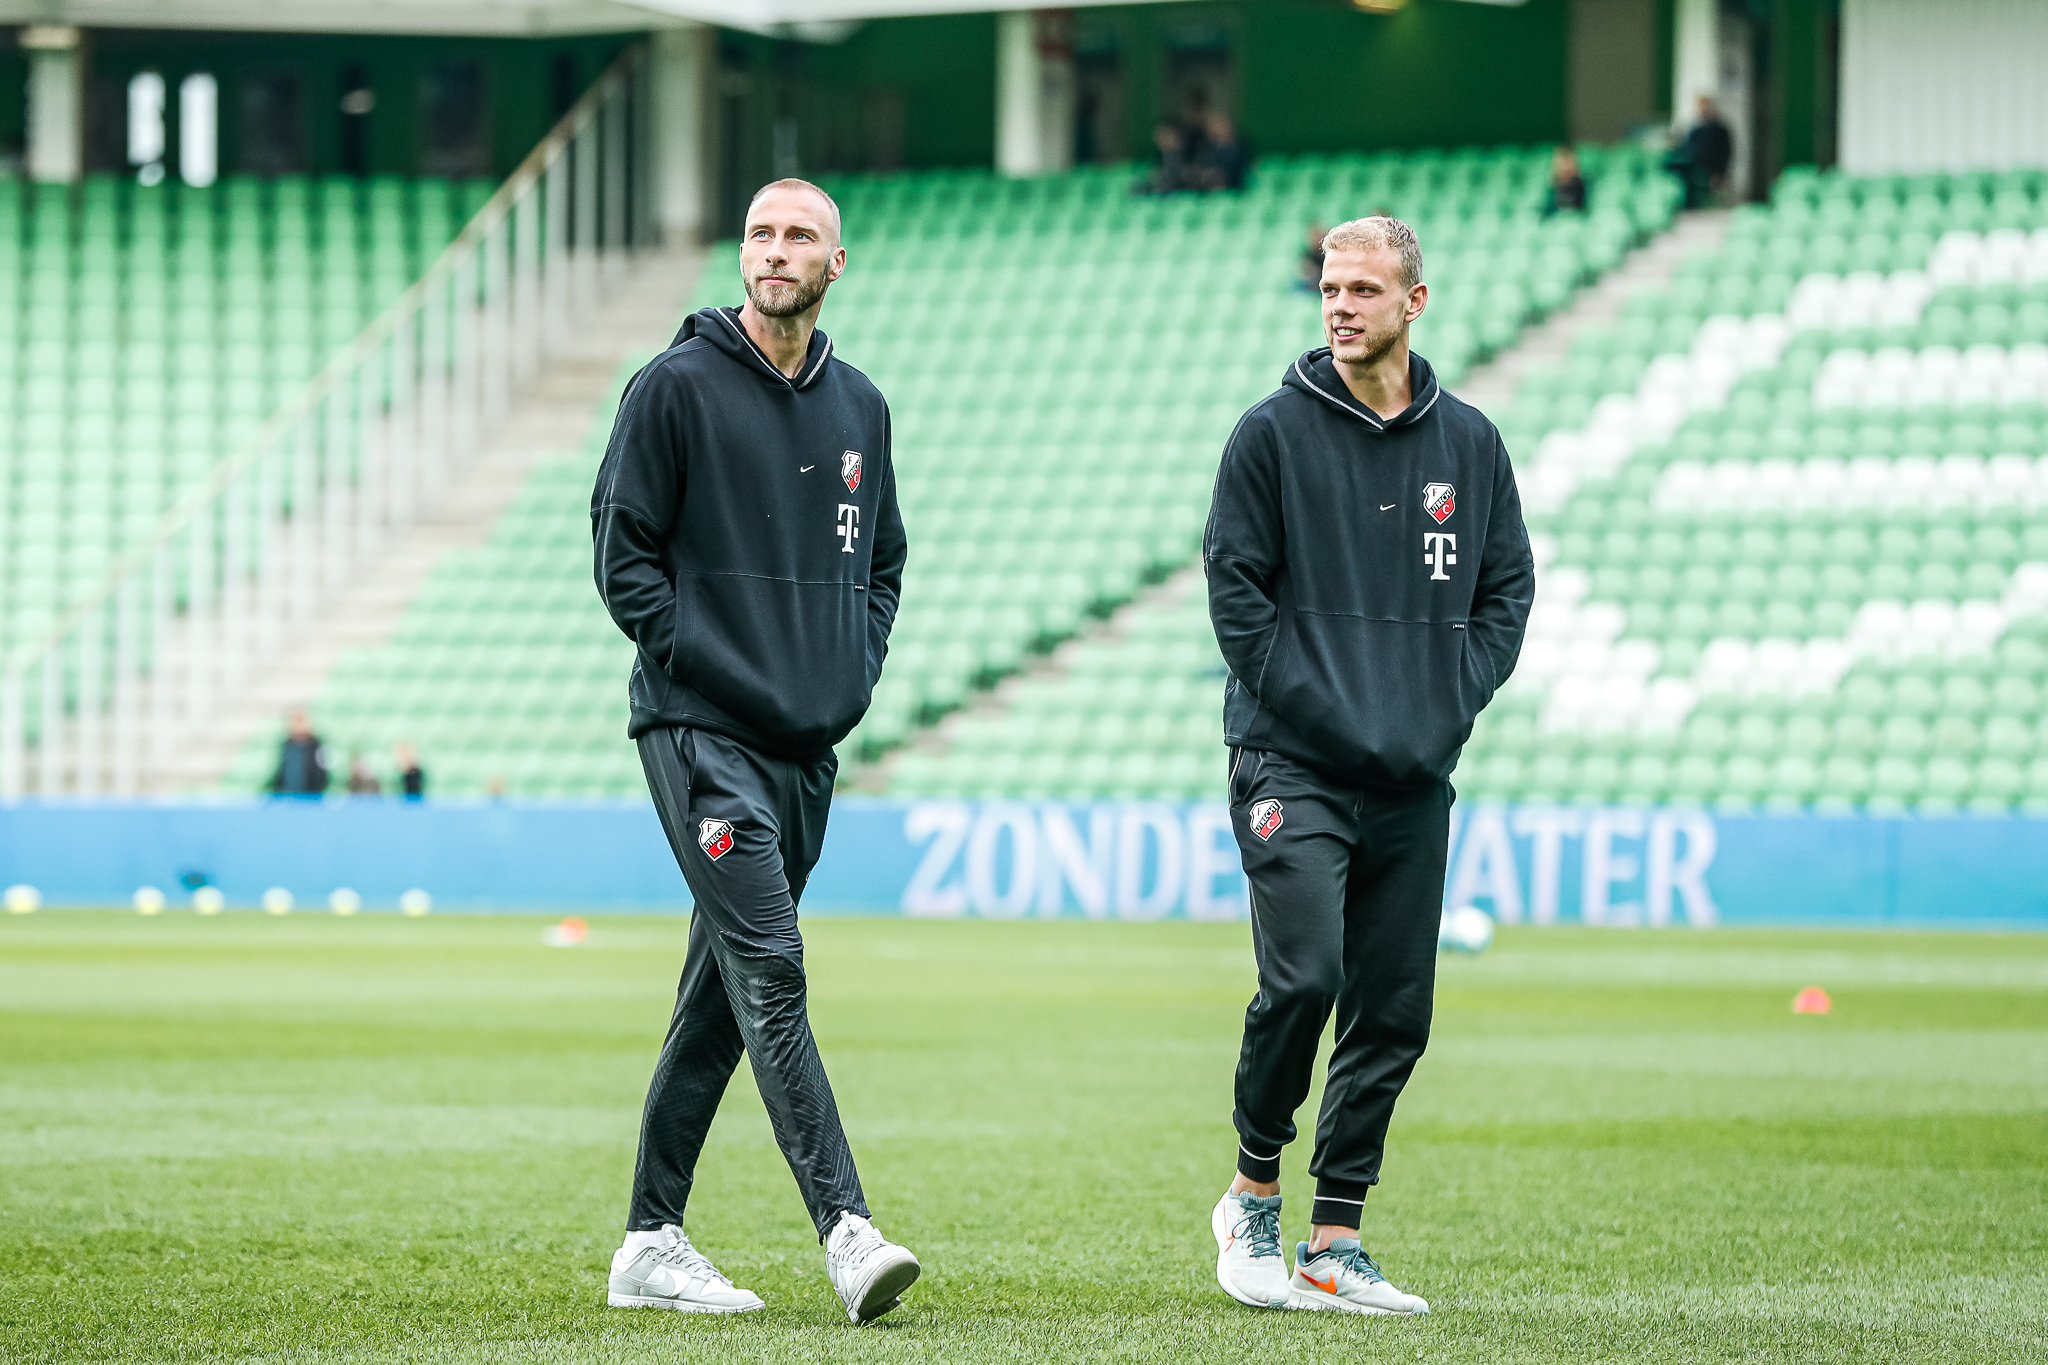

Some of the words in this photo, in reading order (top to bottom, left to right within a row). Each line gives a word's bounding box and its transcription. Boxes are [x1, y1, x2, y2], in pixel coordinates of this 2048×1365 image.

[1442, 504, 1449, 514] C
[837, 503, 859, 553] T
[1424, 532, 1457, 580] T
[702, 823, 729, 850] UTRECHT
[1266, 818, 1275, 829] C
[716, 840, 725, 850] C
[902, 802, 1246, 920] ZONDE
[1447, 806, 1721, 928] ATER
